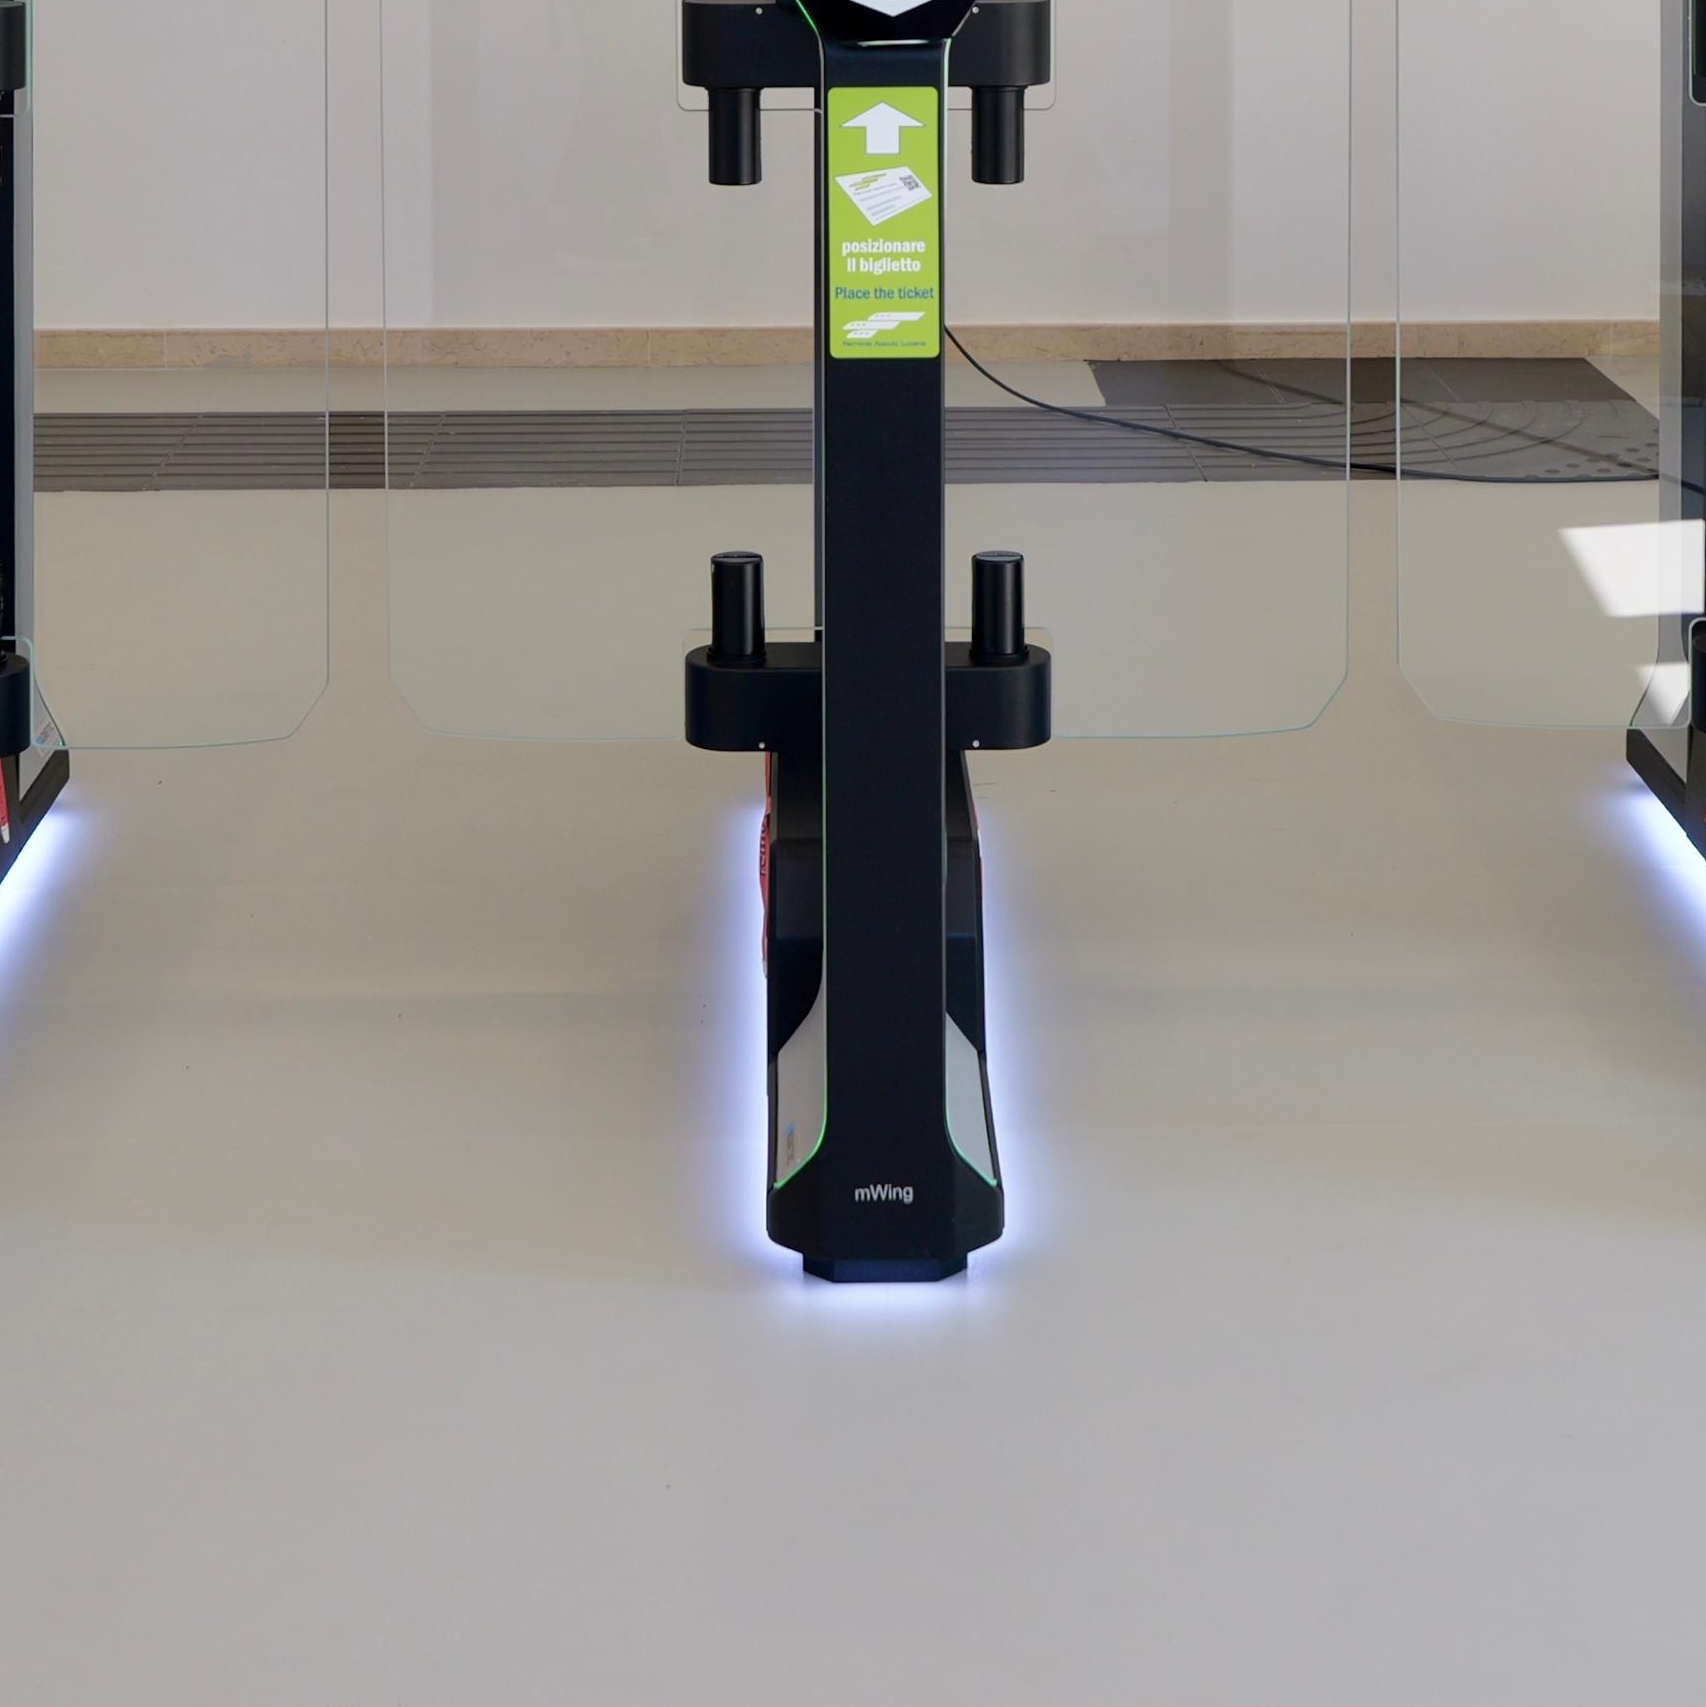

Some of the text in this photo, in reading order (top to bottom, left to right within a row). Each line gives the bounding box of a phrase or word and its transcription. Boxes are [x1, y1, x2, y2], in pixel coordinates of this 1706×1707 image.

[842, 239, 925, 256] posizionare
[847, 257, 921, 275] il biglietto
[834, 286, 934, 300] Place the ticket
[854, 1184, 914, 1205] mWing
